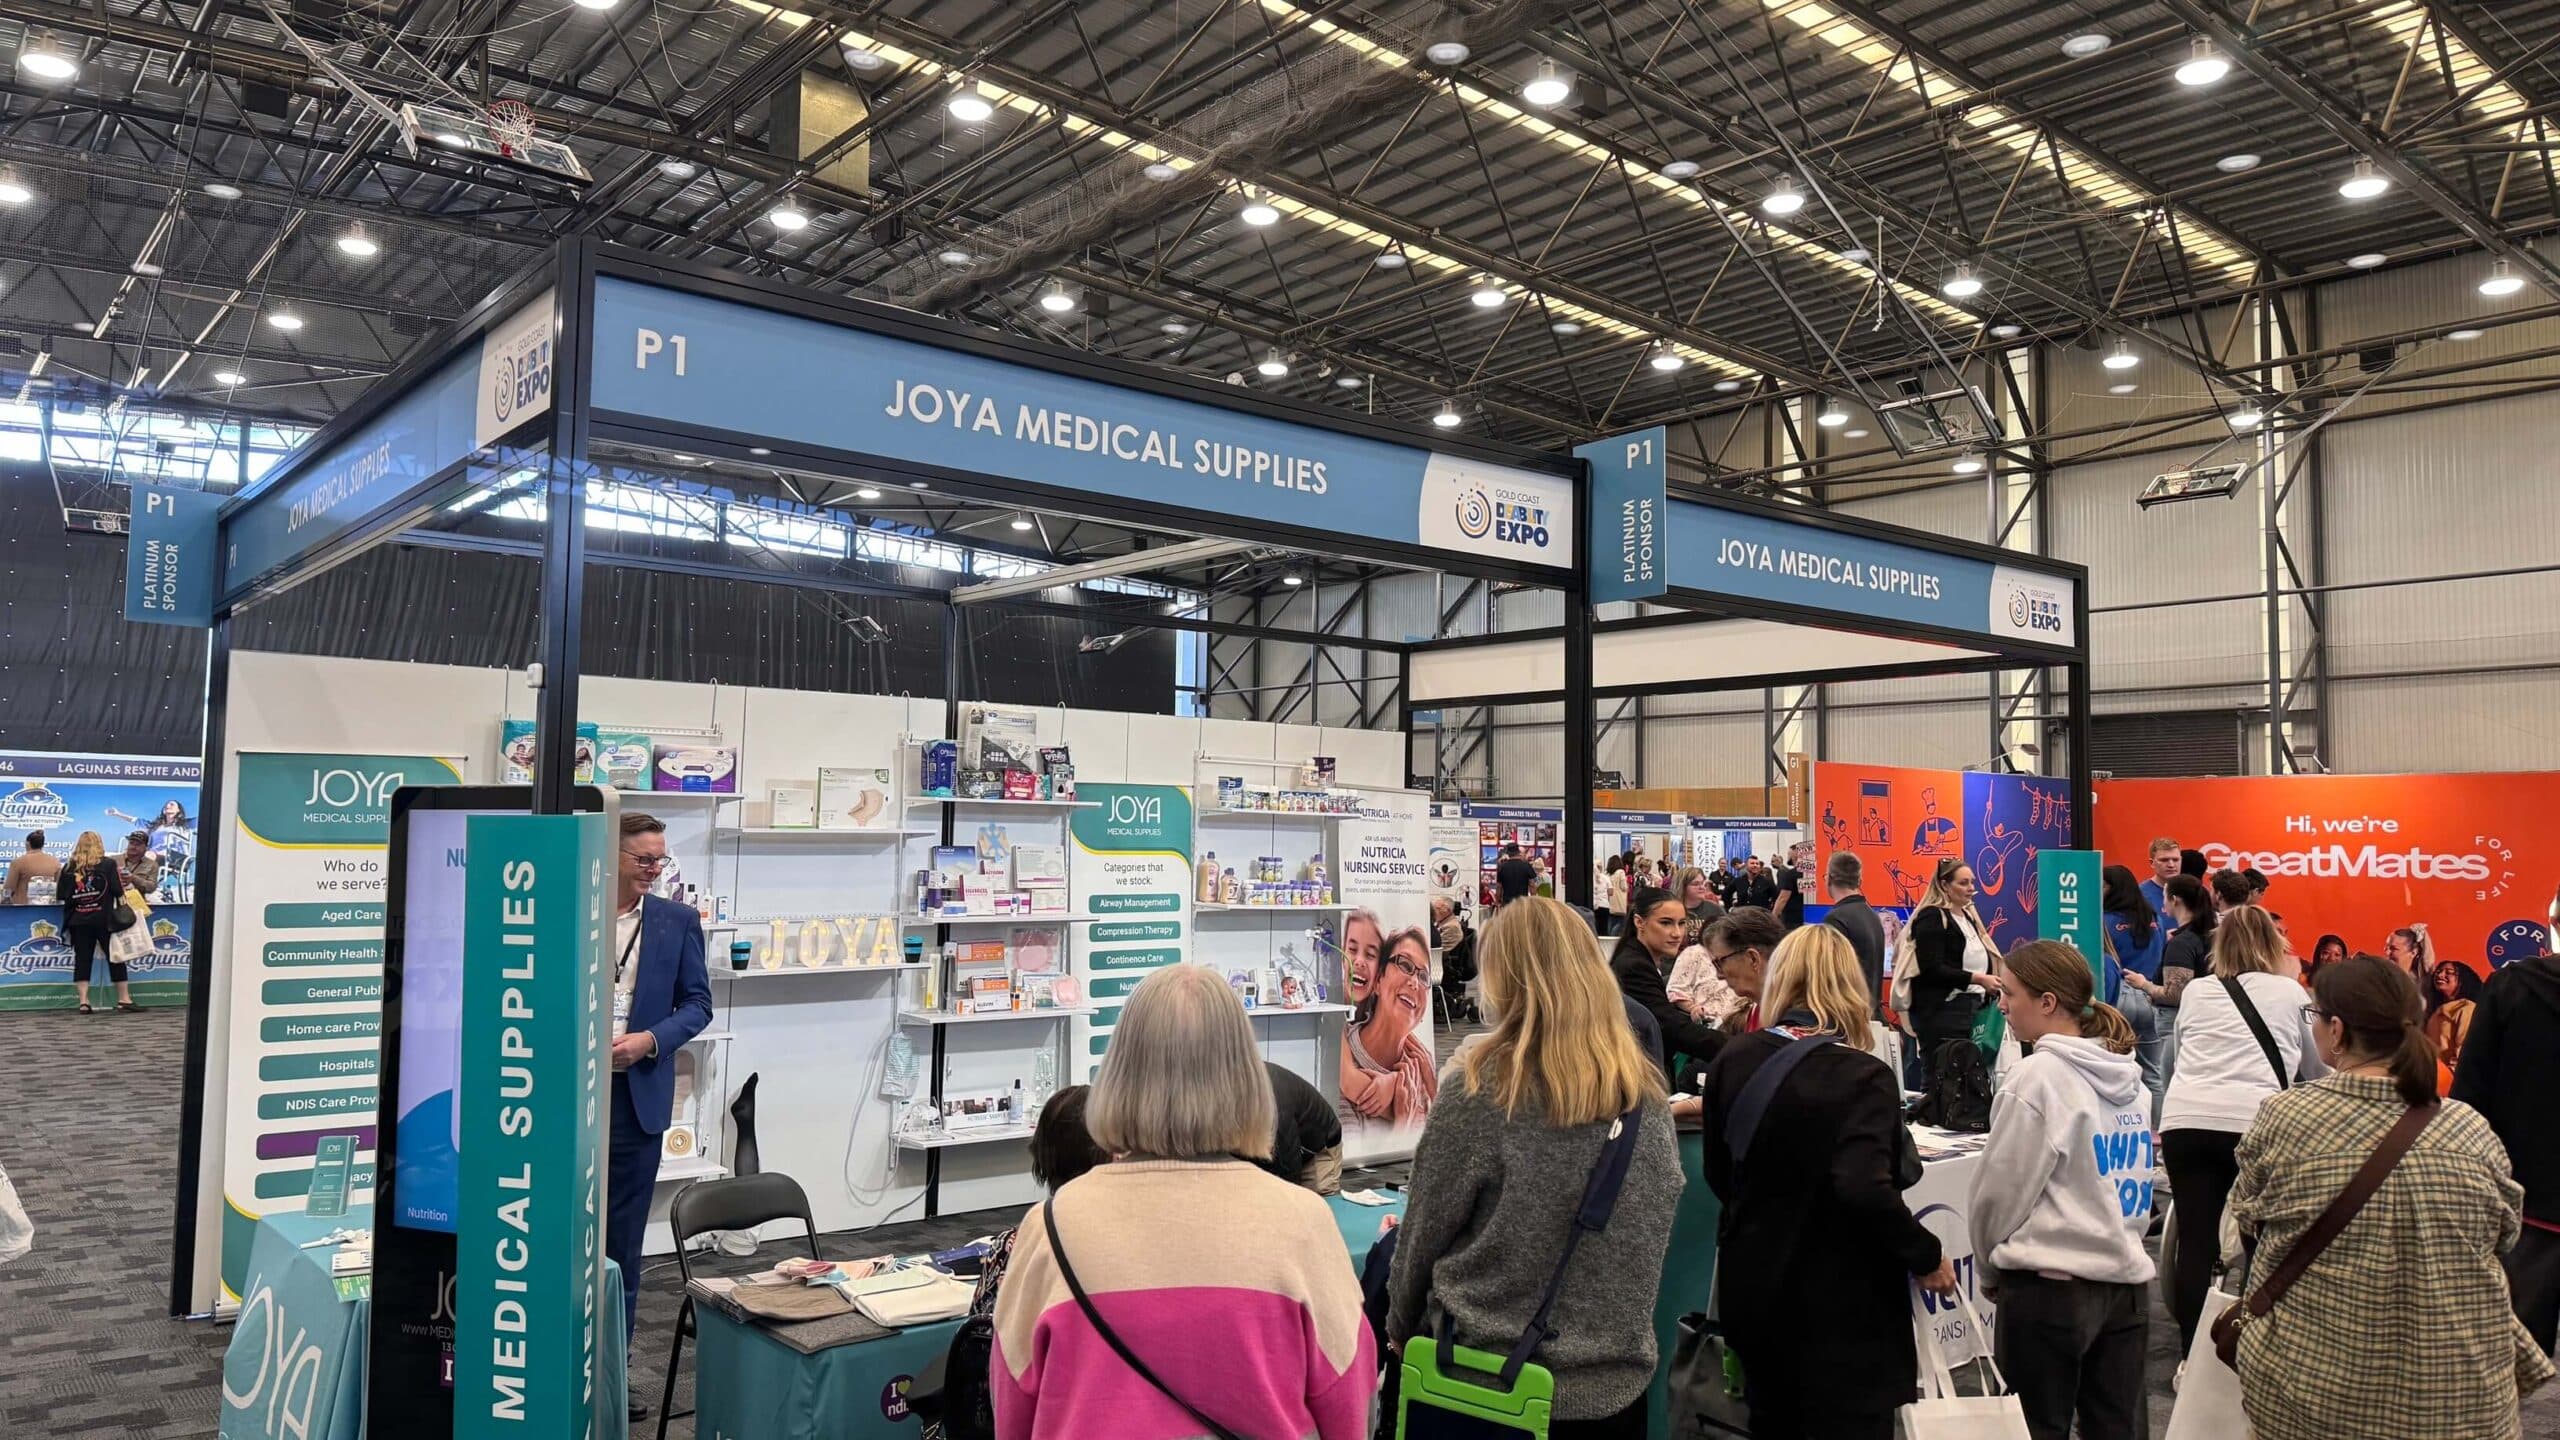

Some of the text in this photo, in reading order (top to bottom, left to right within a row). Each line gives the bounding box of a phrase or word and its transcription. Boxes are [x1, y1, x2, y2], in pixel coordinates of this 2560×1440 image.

[636, 328, 686, 376] P1
[516, 365, 550, 410] EXPO
[885, 379, 1327, 495] JOYA MEDICAL SUPPLIES
[1626, 439, 1652, 469] P1
[288, 442, 391, 534] JOYA MEDICAL SUPPLIES
[1495, 489, 1540, 505] GOLD COAST
[146, 491, 175, 516] P1
[1495, 520, 1550, 548] EXPO
[1623, 499, 1636, 583] PLATINUM
[1640, 498, 1653, 580] SPONSOR
[143, 540, 160, 608] PLATINUM
[162, 544, 179, 611] SPONSOR
[1716, 538, 1940, 600] JOYA MEDICAL SUPPLIES
[2031, 613, 2061, 632] EXPO
[58, 763, 121, 775] LAGUNAS
[124, 764, 169, 776] RESPITE
[172, 766, 200, 777] AND
[0, 800, 66, 817] Lagunas
[1108, 795, 1161, 824] JOYA
[303, 813, 389, 823] MEDICAL SUPPL
[2286, 815, 2399, 835] Hi, we're
[1107, 828, 1133, 836] MEDICAL
[1361, 846, 1407, 859] NUTRICIA
[2475, 836, 2512, 862] FOR
[323, 860, 378, 872] Who do
[1104, 862, 1164, 874] Categories that
[1344, 861, 1425, 876] NURSING SERVICE
[2198, 842, 2490, 881] GreatMates
[317, 878, 388, 890] we serve?
[2475, 871, 2516, 900] LIFE
[1100, 897, 1171, 909] Airway Management
[2059, 871, 2079, 948] PLIES
[321, 910, 381, 922] Aged Care
[1097, 925, 1173, 937] Compression Therapy
[2499, 925, 2545, 943] FOR
[759, 916, 902, 970] JOYA
[1, 953, 74, 971] Laguna
[268, 948, 377, 962] Community Health
[1106, 954, 1164, 964] Continence Care
[307, 985, 381, 998] General Publ
[286, 1021, 380, 1035] Home care Prov
[319, 1058, 375, 1072] Hospitals
[286, 1095, 376, 1111] NDIS Care Prov
[2115, 1113, 2143, 1127] VOL3
[492, 860, 535, 1420] MEDICAL SUPPLIES
[584, 857, 600, 1405] MEDICAL SUPPLIES
[407, 1207, 448, 1222] Nutrition
